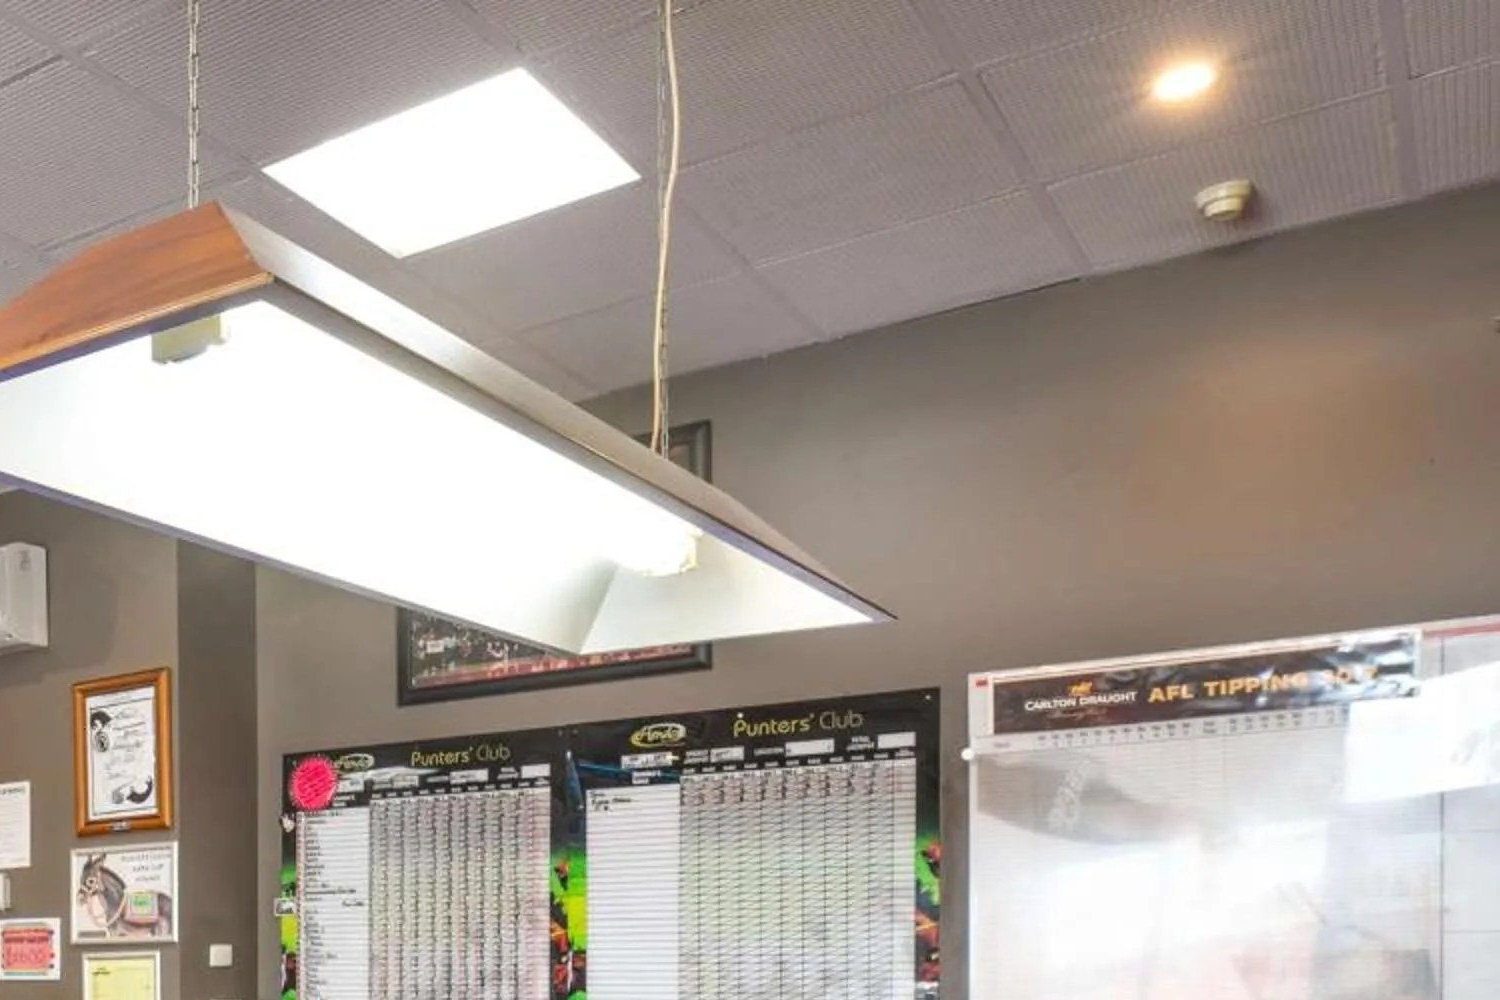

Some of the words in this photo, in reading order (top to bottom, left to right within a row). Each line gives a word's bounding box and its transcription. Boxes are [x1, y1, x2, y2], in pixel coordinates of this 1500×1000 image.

[1148, 684, 1194, 703] AFL
[1203, 671, 1309, 697] TIPPING
[1024, 697, 1076, 711] CARLTON
[1079, 691, 1138, 706] DRAUGHT
[733, 713, 816, 738] Punters'
[819, 710, 864, 730] Club
[411, 747, 474, 767] Punters'
[476, 745, 511, 761] Club
